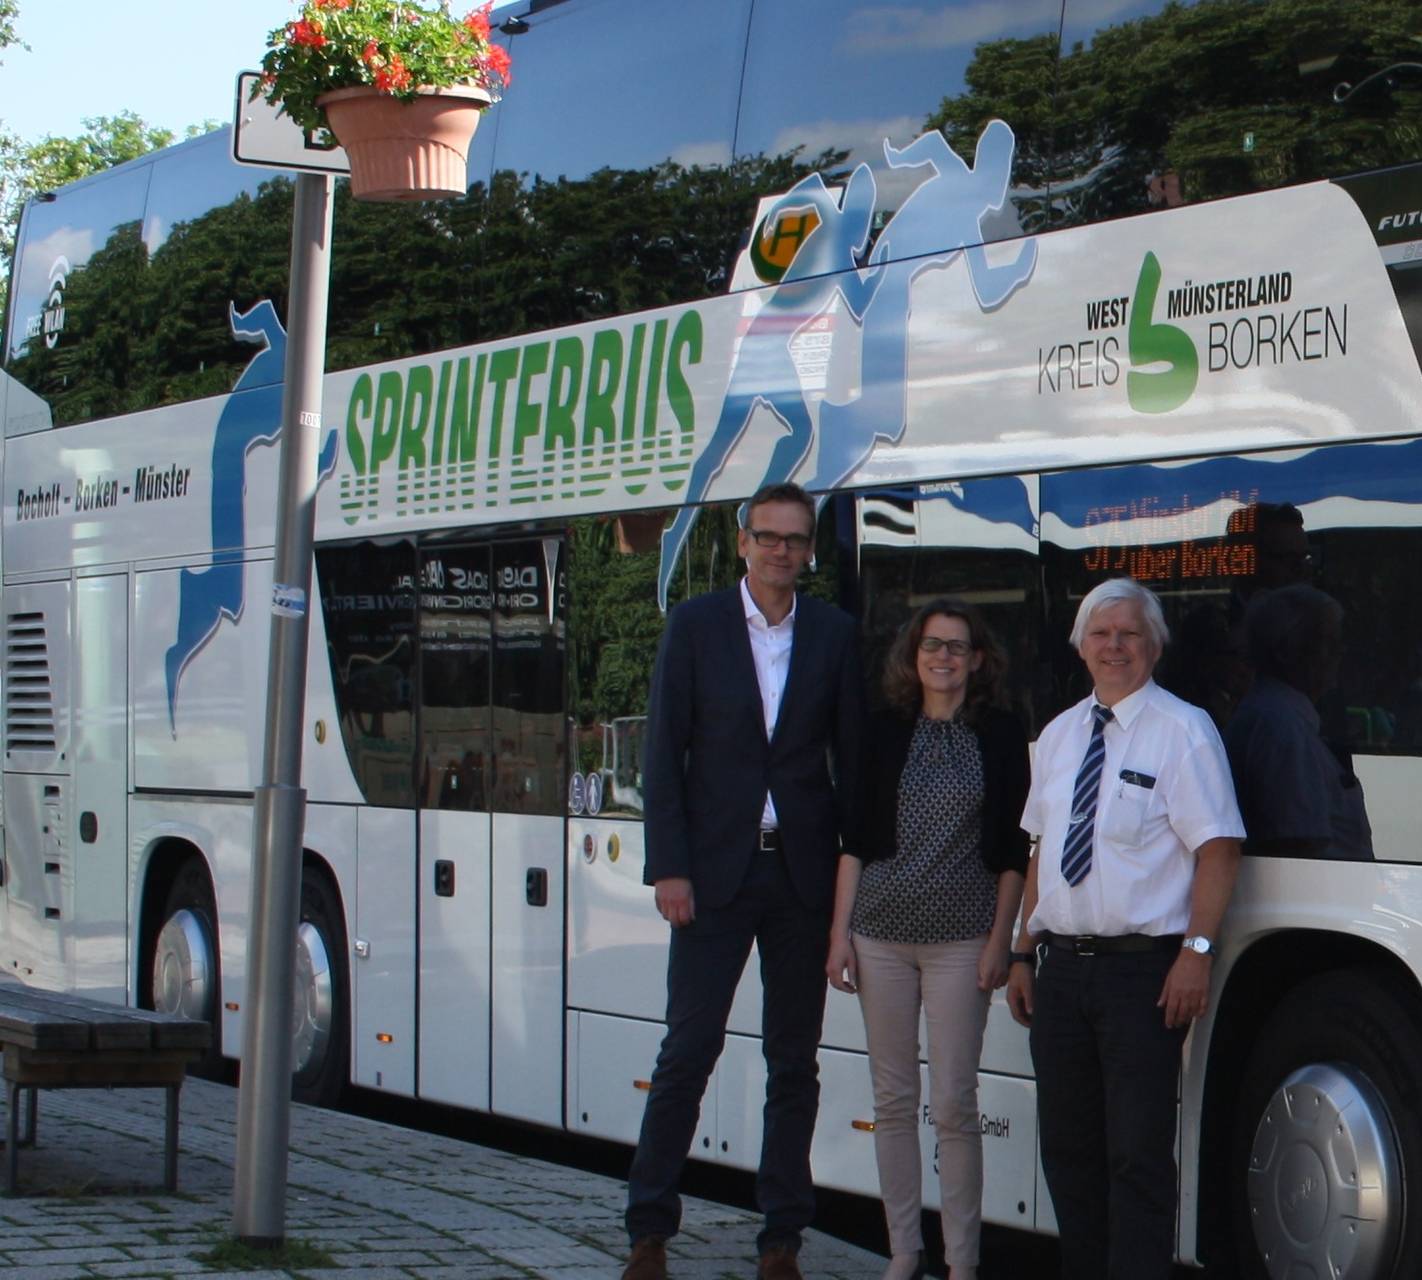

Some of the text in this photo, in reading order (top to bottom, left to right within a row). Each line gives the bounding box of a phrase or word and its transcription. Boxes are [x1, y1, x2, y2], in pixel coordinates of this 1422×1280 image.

[1087, 271, 1292, 331] WEST MÜNSTERLAND
[1037, 303, 1348, 395] KREIS BORKEN
[340, 309, 704, 526] SPRINTERBUS
[16, 482, 61, 522] Bocholt
[75, 475, 119, 513] Borken
[134, 463, 191, 504] Münster
[980, 1113, 1010, 1138] GmbH
